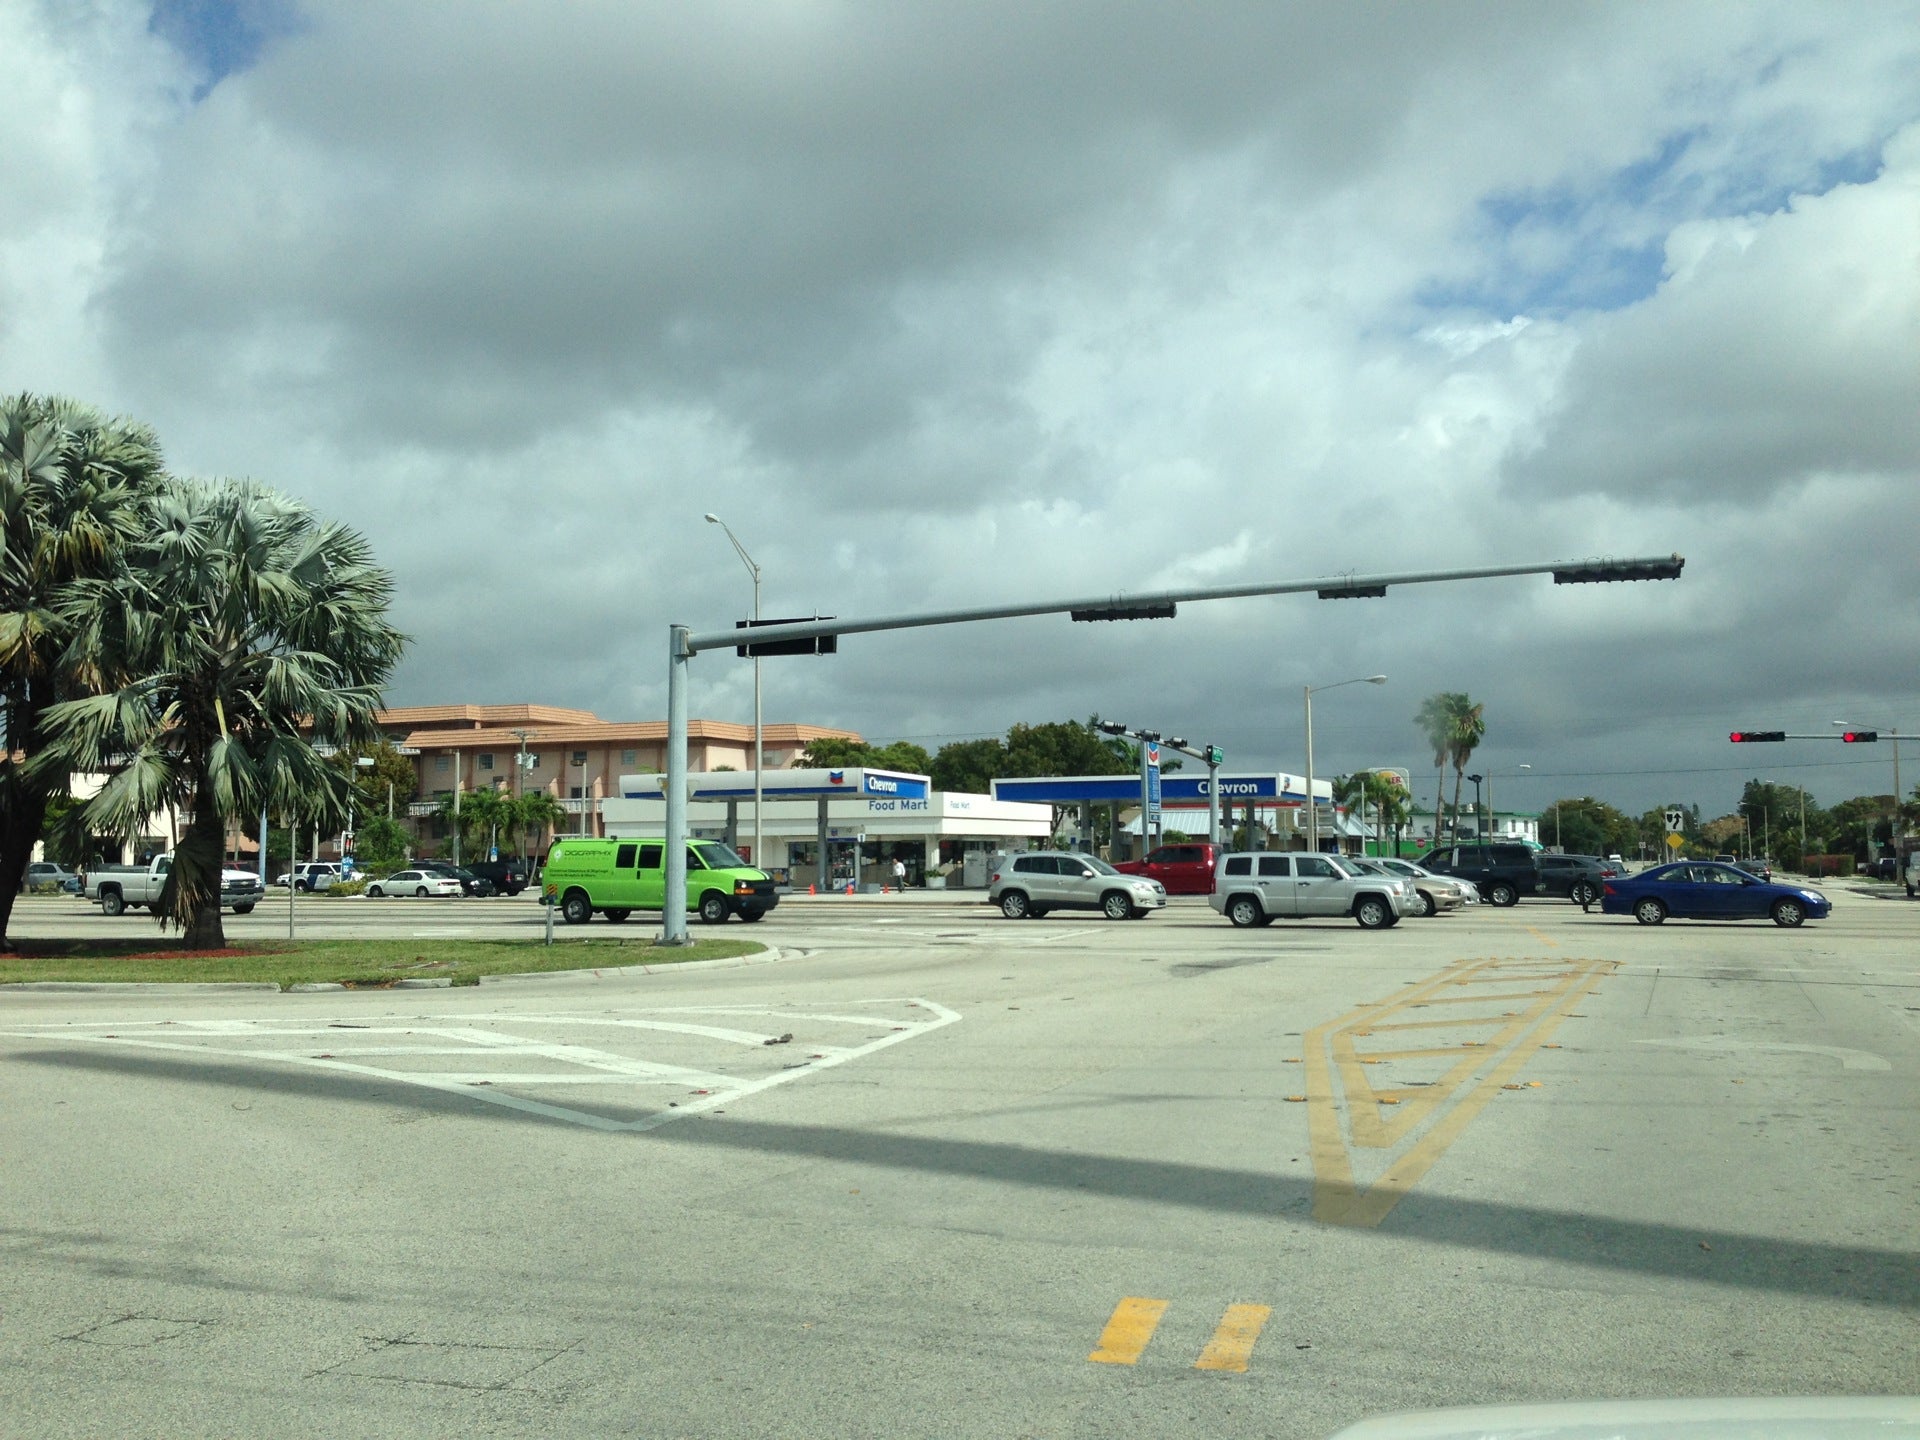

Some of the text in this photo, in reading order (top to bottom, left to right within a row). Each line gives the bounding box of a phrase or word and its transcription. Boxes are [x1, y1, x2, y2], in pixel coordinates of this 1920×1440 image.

[869, 776, 897, 792] Chevron
[869, 800, 928, 811] Food Mart
